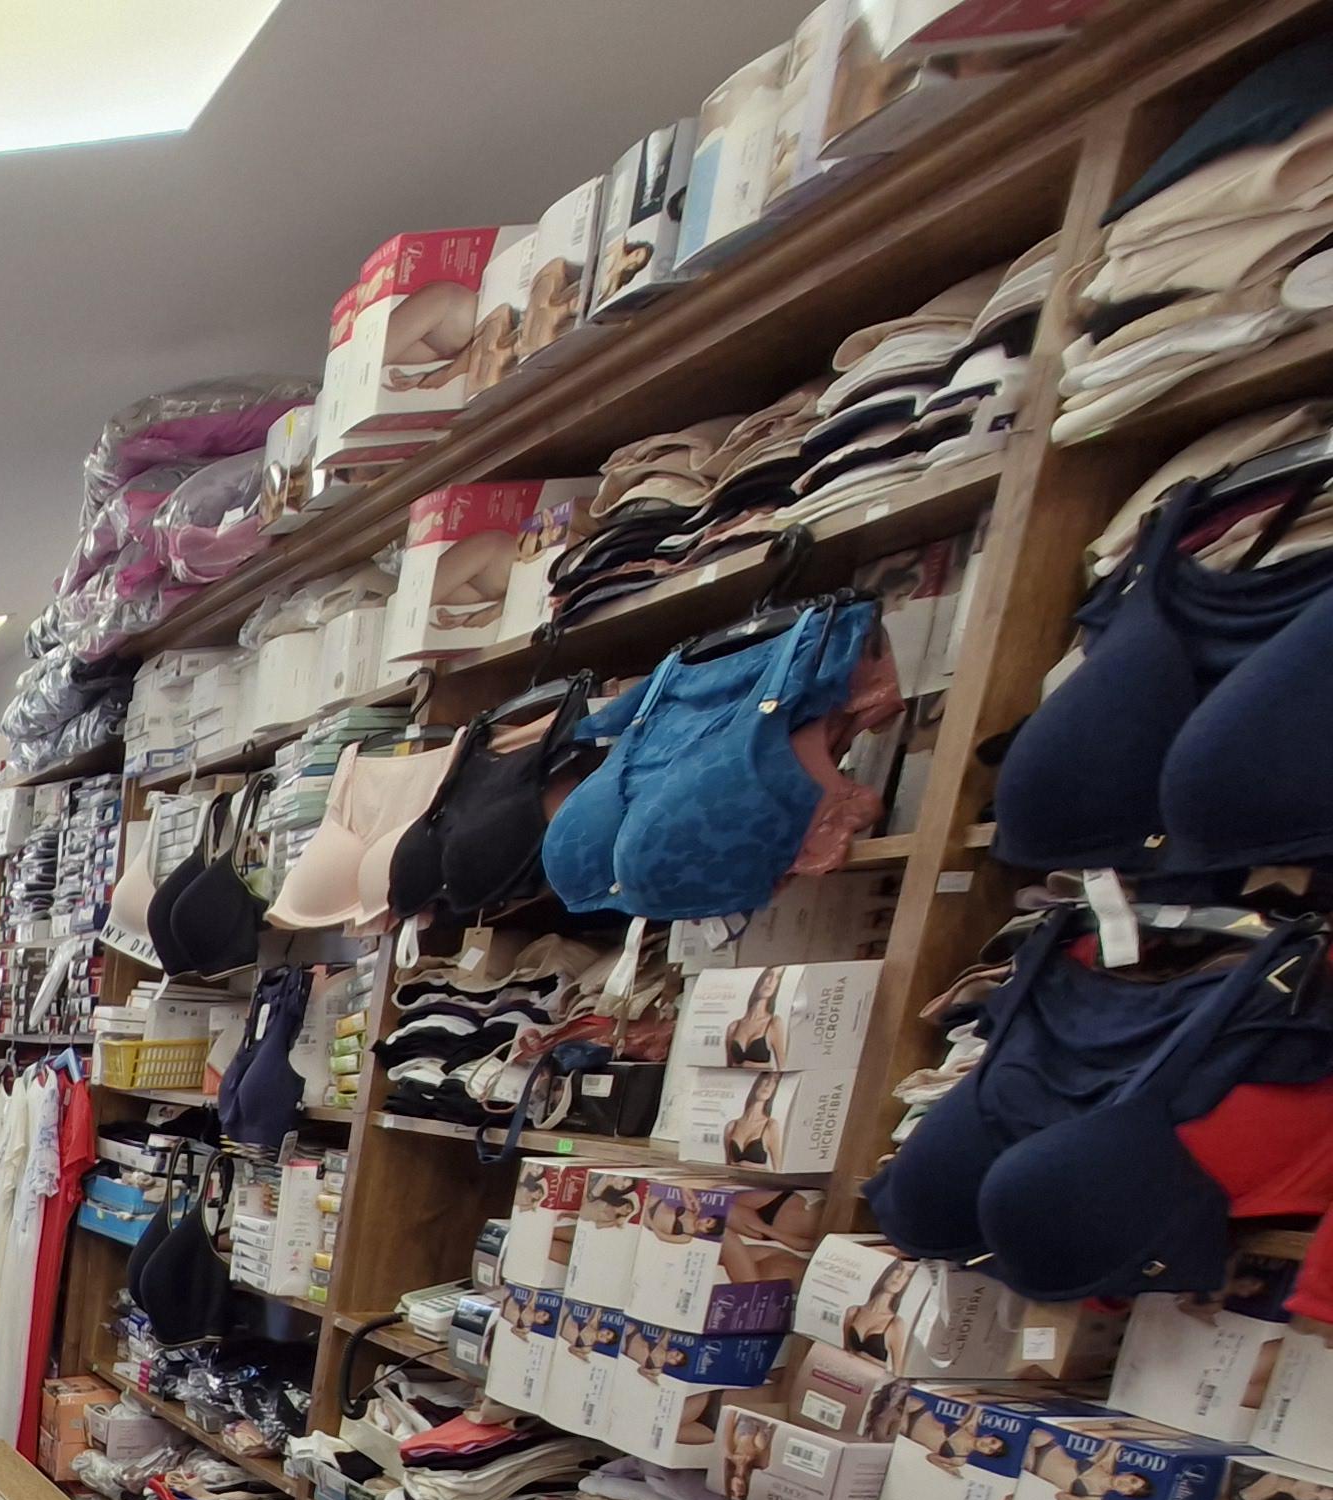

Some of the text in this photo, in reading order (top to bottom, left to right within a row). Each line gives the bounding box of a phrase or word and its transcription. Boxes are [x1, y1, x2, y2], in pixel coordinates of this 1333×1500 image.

[813, 987, 833, 1047] LORMAR
[822, 975, 848, 1056] MICROFIBRA
[810, 1094, 829, 1150] LORMAR
[818, 1083, 844, 1161] MICROFIBRA
[977, 1411, 1022, 1434] GOOD
[1116, 1450, 1168, 1472] GOOD
